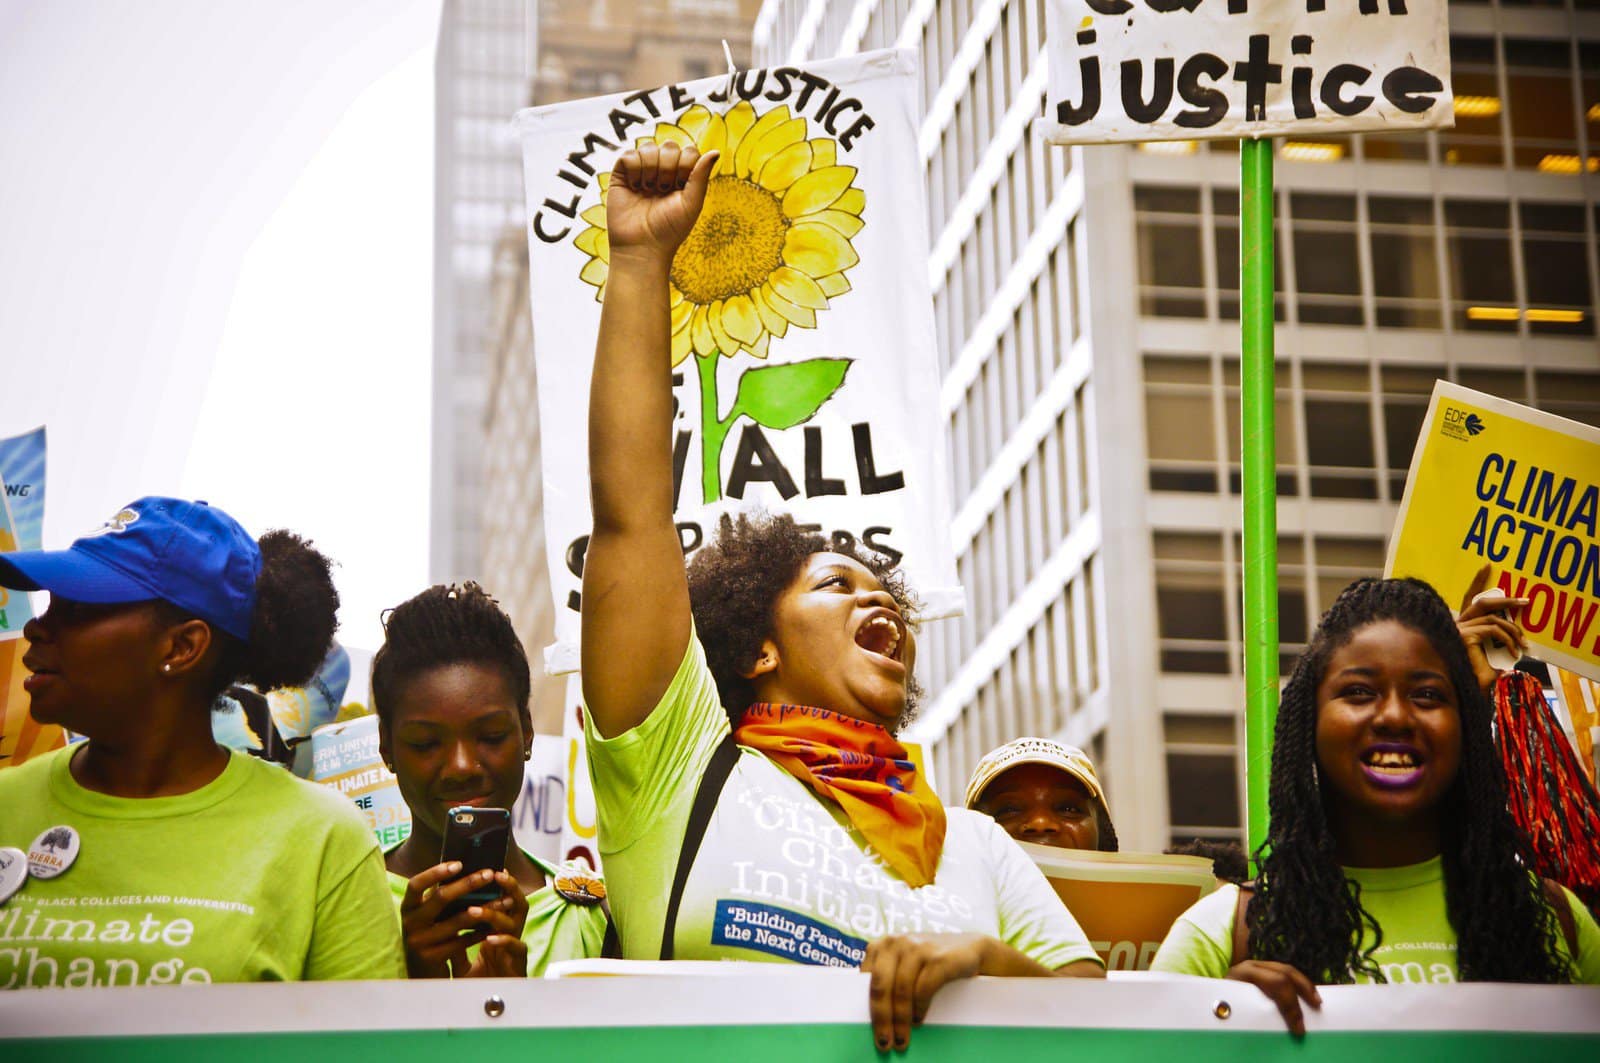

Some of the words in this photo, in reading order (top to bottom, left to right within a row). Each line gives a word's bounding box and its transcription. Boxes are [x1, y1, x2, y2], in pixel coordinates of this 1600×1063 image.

[1057, 30, 1443, 128] justice
[532, 84, 697, 244] CLIMATE
[708, 66, 876, 152] JUSTICE
[1444, 407, 1467, 424] EDF
[673, 421, 906, 515] ALL
[1476, 452, 1600, 538] CLIMA
[1462, 506, 1600, 597] ACTION
[1497, 570, 1600, 656] NOW
[512, 774, 564, 834] ND
[28, 851, 63, 867] SIERRA
[0, 906, 194, 947] limate
[37, 897, 76, 906] BLACK
[80, 895, 141, 906] COLLEGES
[144, 895, 171, 904] AND
[174, 895, 255, 915] UNIVERSITIES
[725, 924, 751, 941] the
[755, 925, 796, 953] Next
